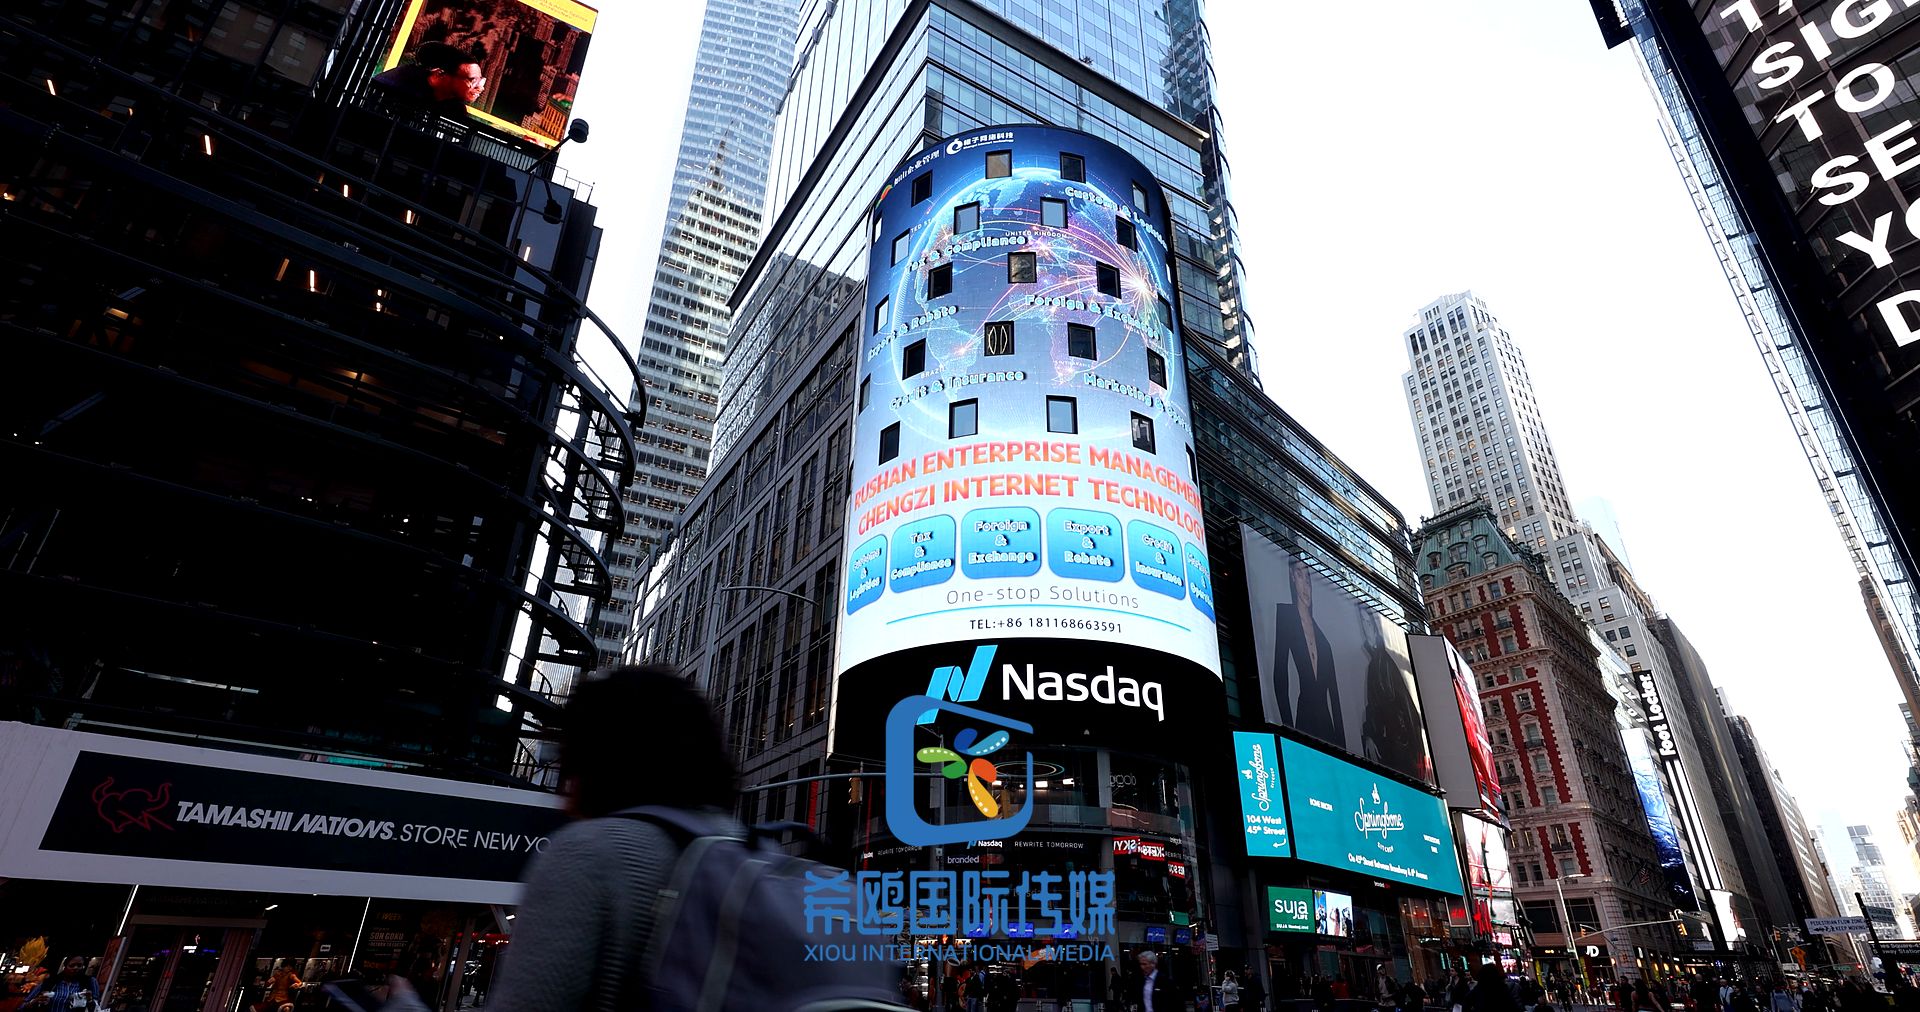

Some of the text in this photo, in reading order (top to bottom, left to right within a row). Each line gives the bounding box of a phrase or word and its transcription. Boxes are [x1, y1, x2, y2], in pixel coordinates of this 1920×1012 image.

[1751, 0, 1920, 90] SIG
[1775, 62, 1896, 142] TO
[944, 235, 1028, 255] Compliance
[1025, 294, 1085, 311] Foreign
[1088, 301, 1102, 315] &
[911, 305, 959, 330] Rebate
[930, 379, 945, 393] &
[947, 370, 1027, 388] Insurance
[1083, 373, 1154, 407] Marketing
[854, 440, 1202, 516] RUSHAN ENTERPRISE MANAGEMEN
[858, 485, 936, 535] CHENGZI
[943, 473, 1079, 503] INTERNET
[974, 520, 1030, 532] Foreign
[1064, 520, 1112, 536] Export
[910, 531, 934, 544] Tax
[994, 534, 1009, 547] &
[1081, 536, 1095, 550] &
[1142, 534, 1175, 554] Credit
[914, 546, 927, 558] &
[968, 550, 1037, 564] Exchange
[1064, 551, 1113, 567] Rebate
[1154, 552, 1167, 566] &
[890, 558, 954, 581] Compliance
[947, 585, 1139, 609] One-stop Solutions
[1028, 617, 1122, 633] 181168663591
[1001, 664, 1165, 722] Nasdaq
[1639, 673, 1677, 756] Foot Locker
[176, 801, 294, 831] TAMASHII
[400, 823, 470, 849] STORE
[474, 830, 521, 851] NEW
[524, 835, 551, 853] YO
[1246, 814, 1282, 825] 104 West
[977, 840, 1003, 848] Nasdaq
[1046, 841, 1084, 849] TOMORROW
[947, 855, 980, 864] branded
[1274, 899, 1308, 920] suja
